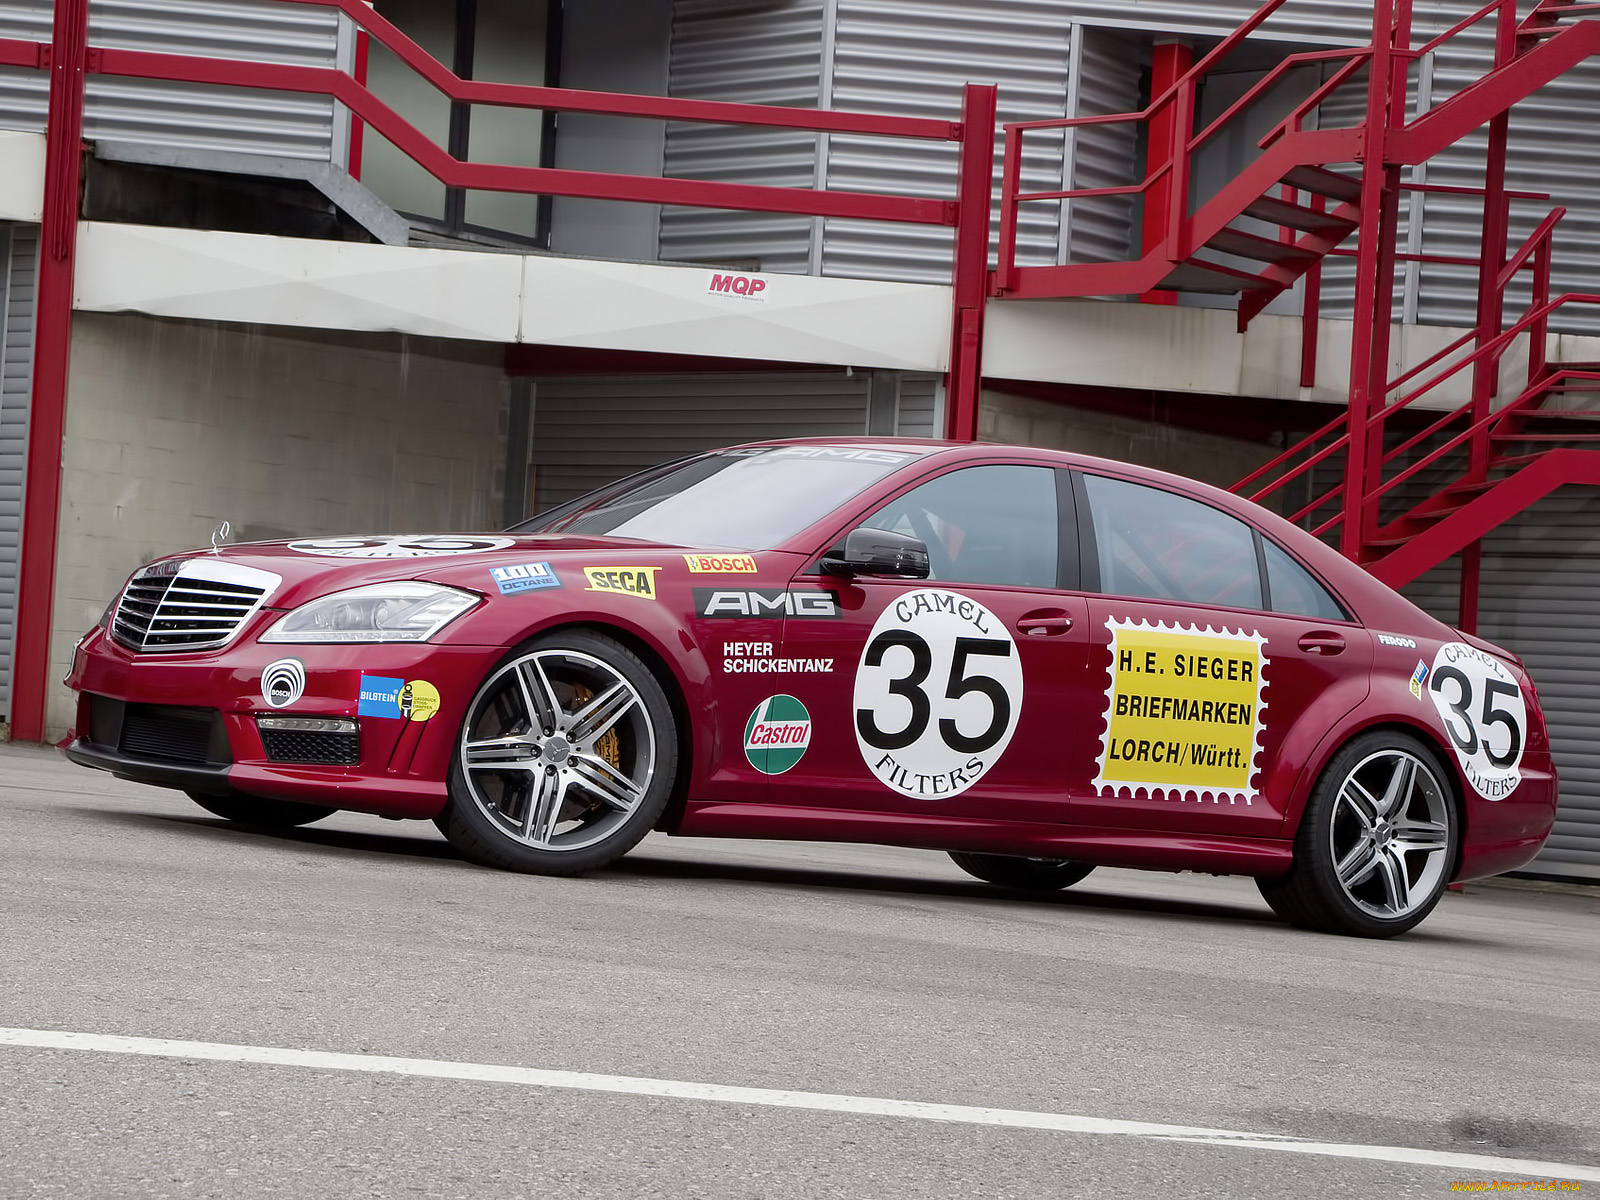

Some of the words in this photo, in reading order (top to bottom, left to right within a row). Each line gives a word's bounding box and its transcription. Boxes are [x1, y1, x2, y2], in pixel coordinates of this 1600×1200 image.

[709, 273, 766, 296] MQP
[493, 563, 549, 581] 100
[698, 558, 755, 571] BOSCH
[502, 577, 555, 591] OCTANE
[591, 571, 652, 595] SECA
[703, 591, 836, 615] AMG
[895, 592, 989, 635] CAMEL
[723, 642, 773, 656] HEYER
[1378, 634, 1417, 649] FERODO
[723, 658, 834, 673] SCHICKENTANZ
[1119, 649, 1165, 675] H.E.
[1174, 654, 1253, 683] SIEGER
[1444, 645, 1504, 679] CAMEL
[271, 688, 291, 698] BOSCH
[857, 628, 1011, 754] 35
[1115, 693, 1252, 726] BRIEFMARKEN
[1431, 665, 1521, 770] 35
[750, 723, 809, 745] Castrol
[1109, 738, 1248, 769] LORCH/Württ.
[875, 752, 984, 794] FILTERS
[1464, 760, 1518, 796] FILTERS
